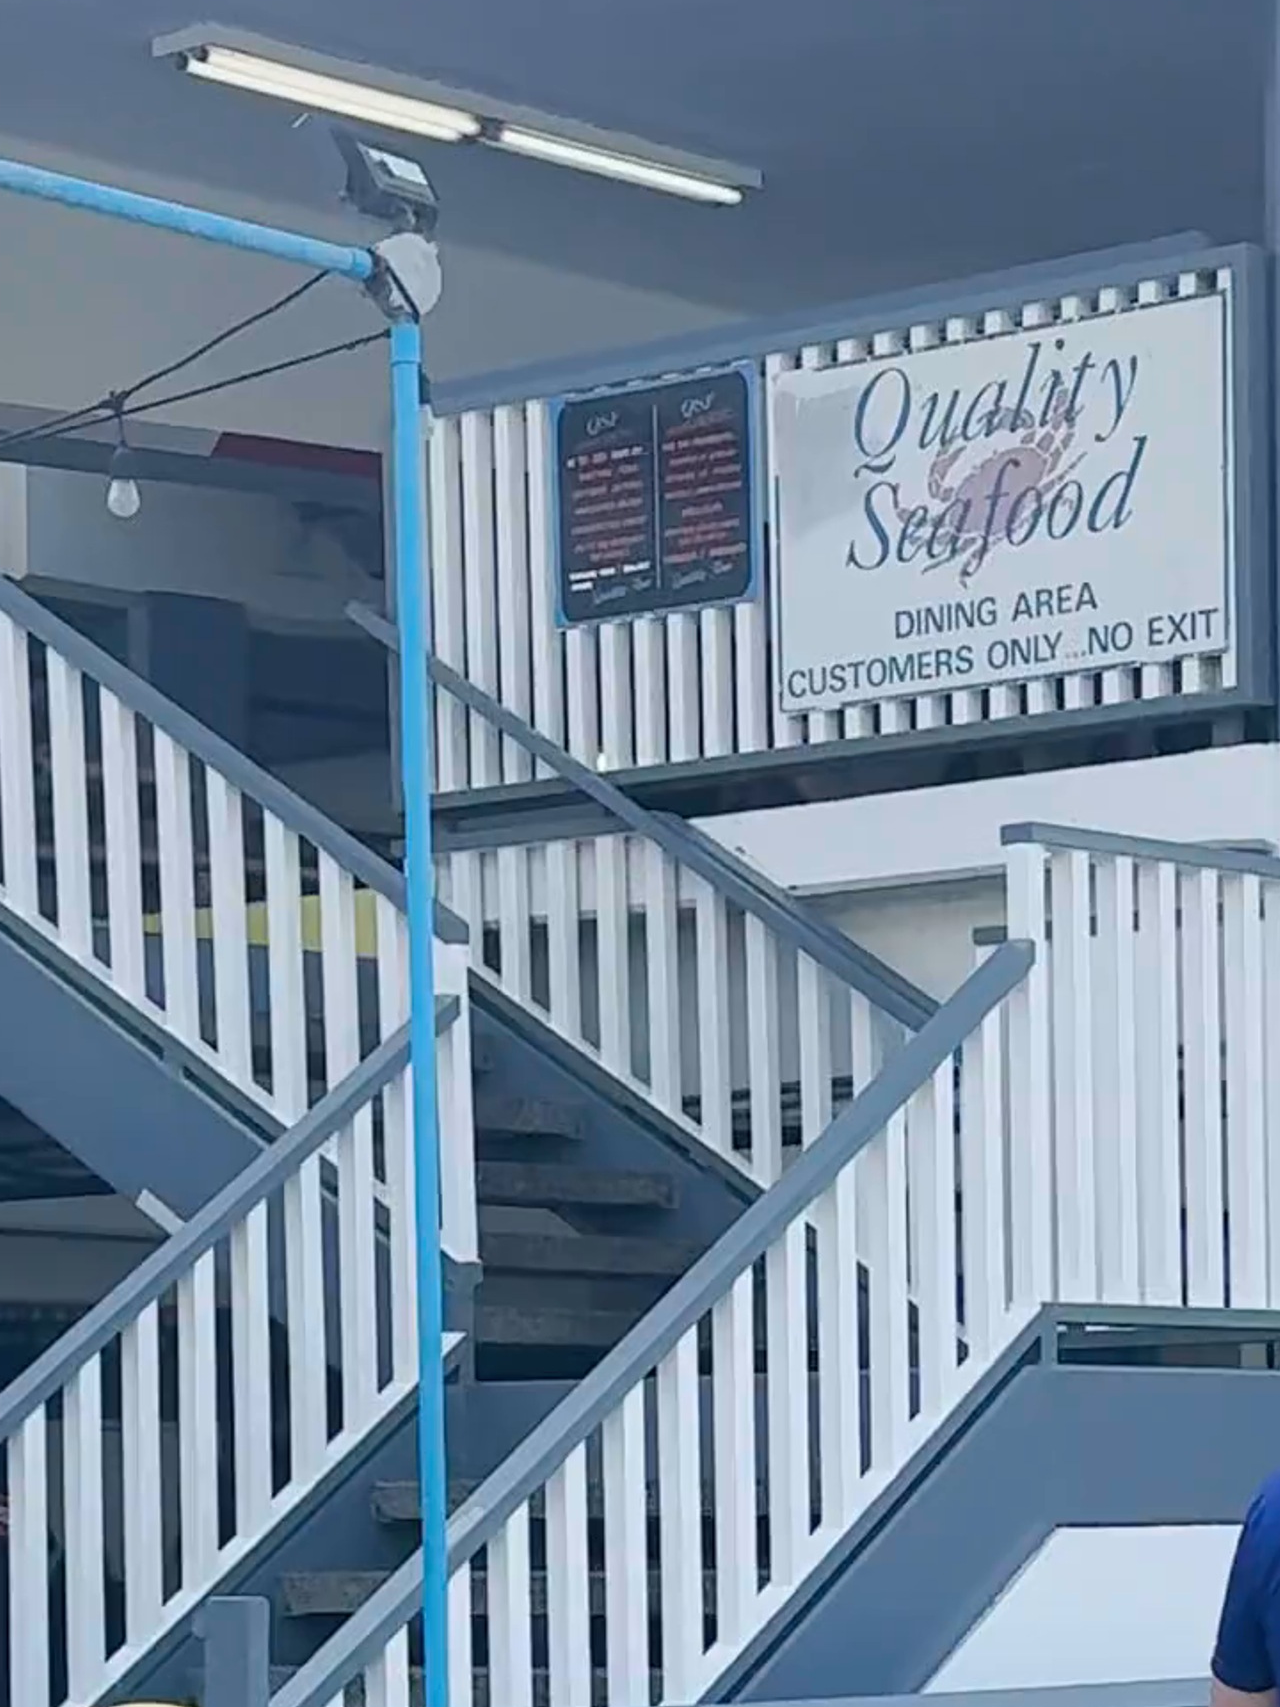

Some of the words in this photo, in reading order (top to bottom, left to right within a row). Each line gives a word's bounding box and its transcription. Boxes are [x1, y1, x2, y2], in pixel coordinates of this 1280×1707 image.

[852, 337, 1139, 480] Quality
[847, 434, 1149, 578] Seafood
[787, 644, 975, 699] CUSTOMERS
[1148, 606, 1220, 648] EXIT
[894, 596, 998, 640] DINING
[1011, 582, 1099, 623] AREA
